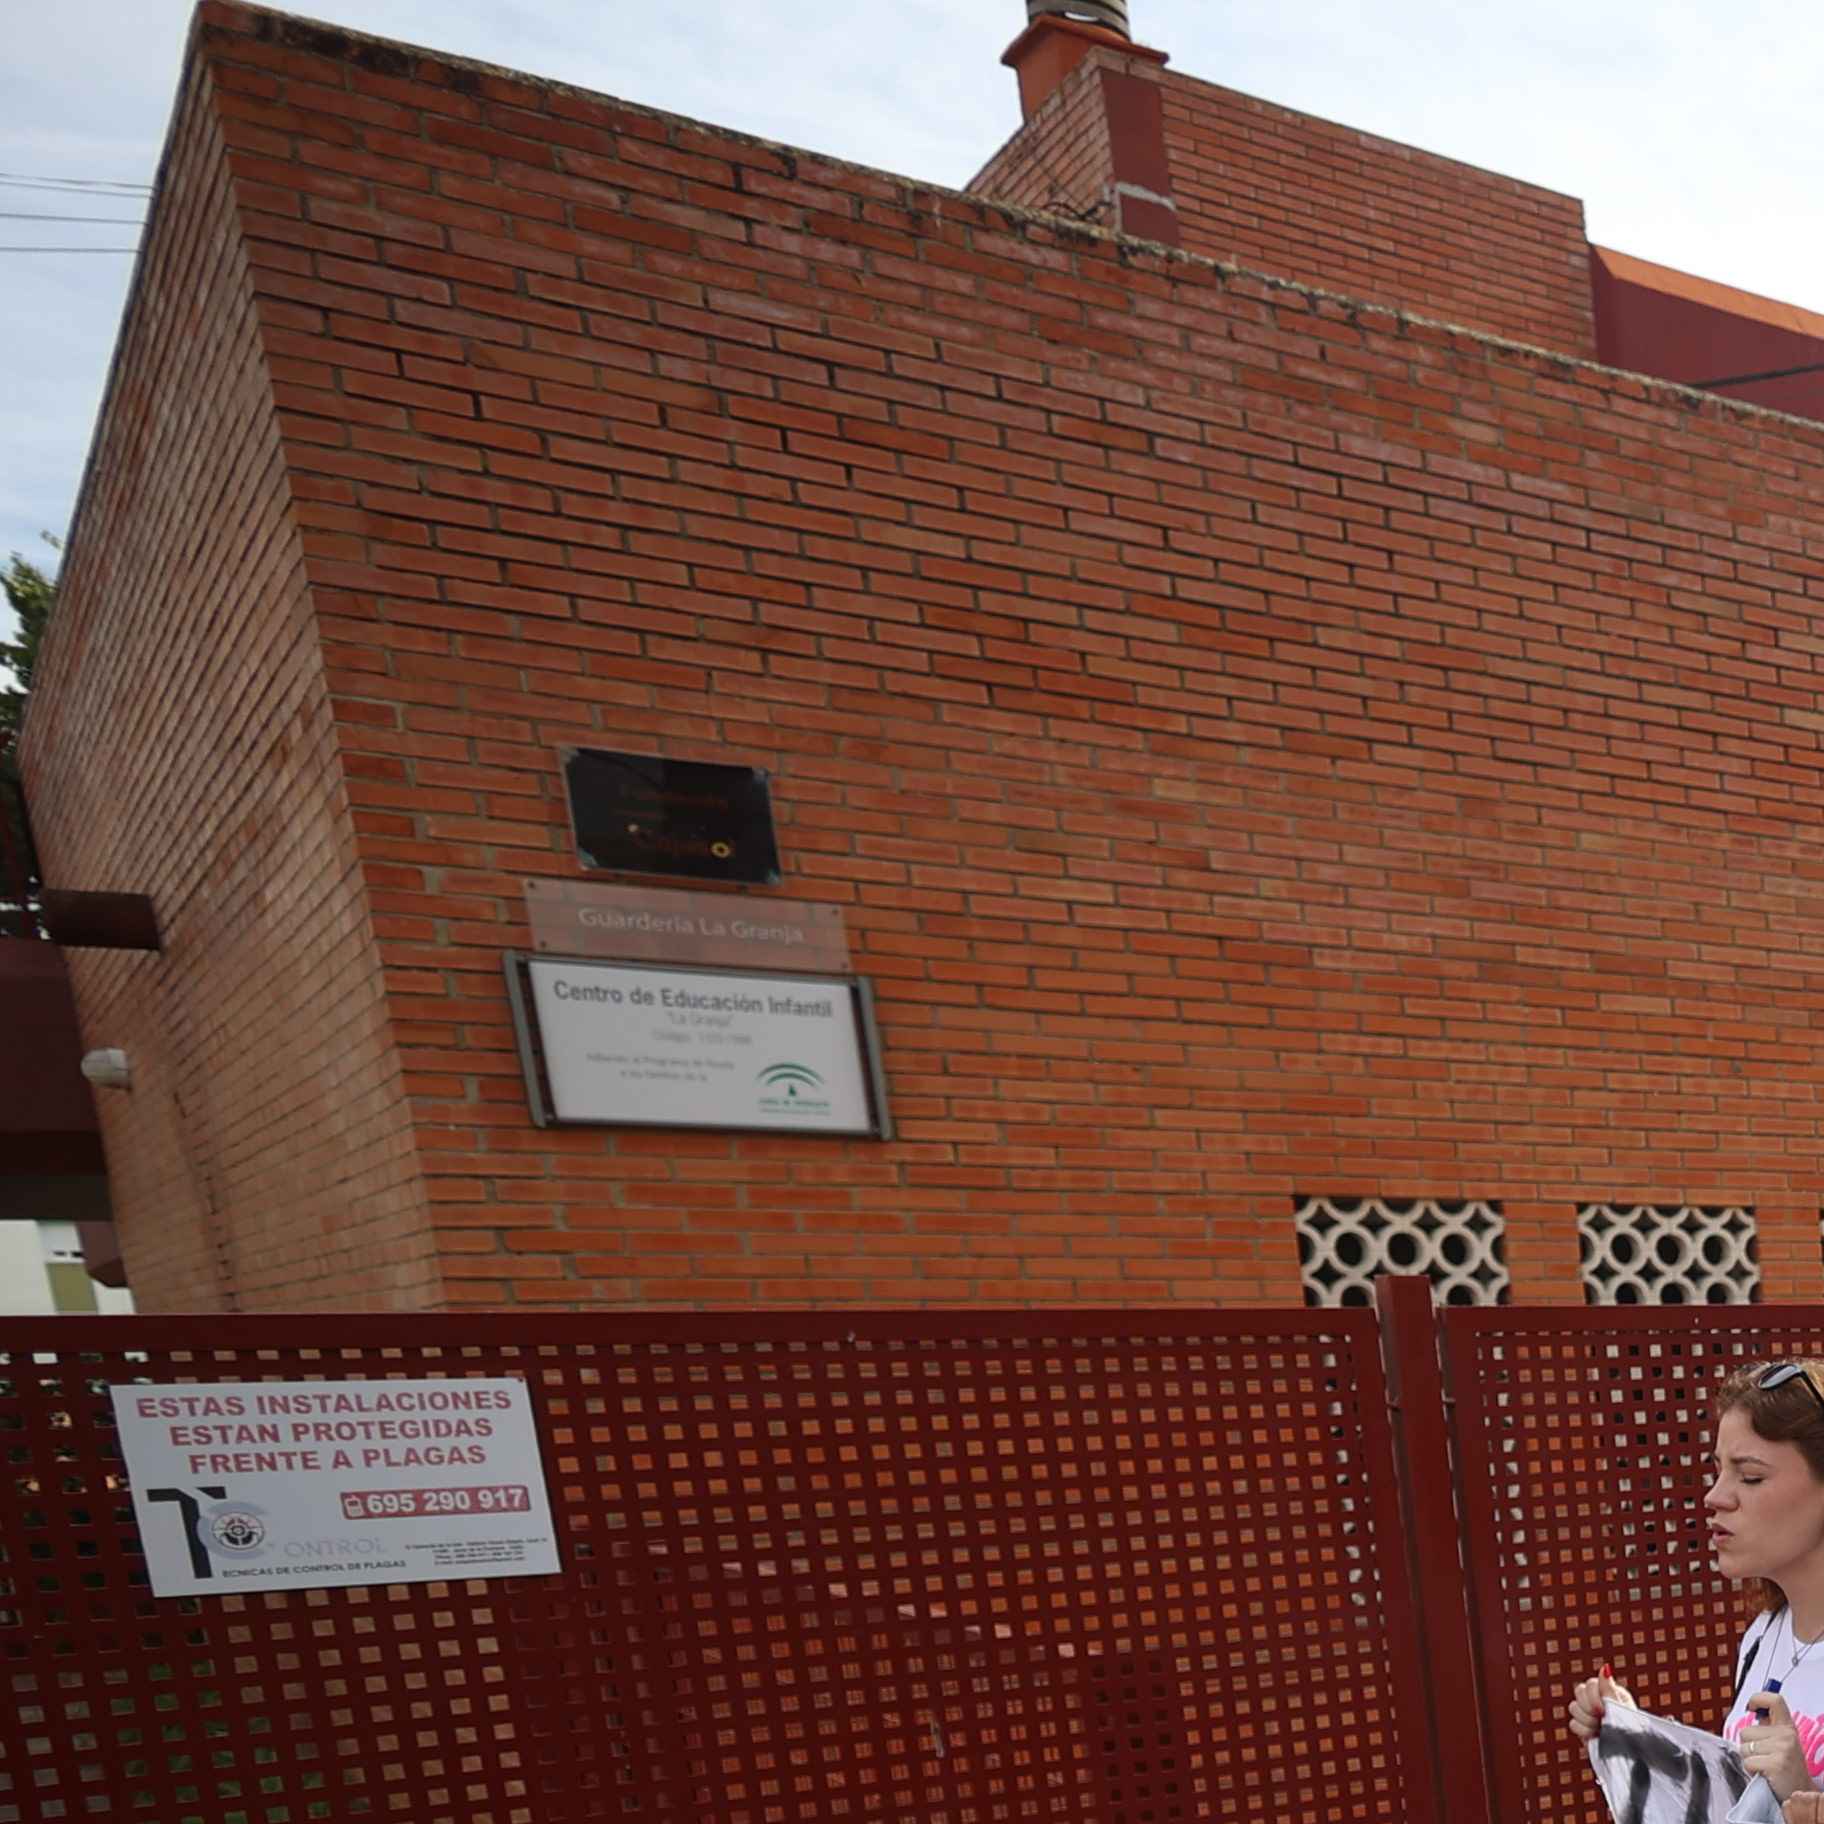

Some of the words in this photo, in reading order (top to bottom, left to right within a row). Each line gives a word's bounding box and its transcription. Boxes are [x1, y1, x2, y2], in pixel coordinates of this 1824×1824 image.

[553, 979, 623, 1004] Centro
[629, 986, 655, 1006] de
[660, 987, 762, 1013] Educación
[767, 995, 833, 1018] Infantil
[137, 1395, 246, 1419] ESTAS
[256, 1389, 513, 1416] INSTALACIONES
[169, 1423, 282, 1447] ESTAN
[292, 1417, 494, 1444] PROTEGIDAS
[188, 1450, 321, 1475] FRENTE
[330, 1450, 354, 1470] A
[362, 1444, 487, 1468] PLAGAS
[366, 1492, 416, 1515] 695
[422, 1490, 471, 1512] 290
[477, 1488, 524, 1510] 917
[275, 1565, 292, 1577] DE
[347, 1562, 362, 1573] DE
